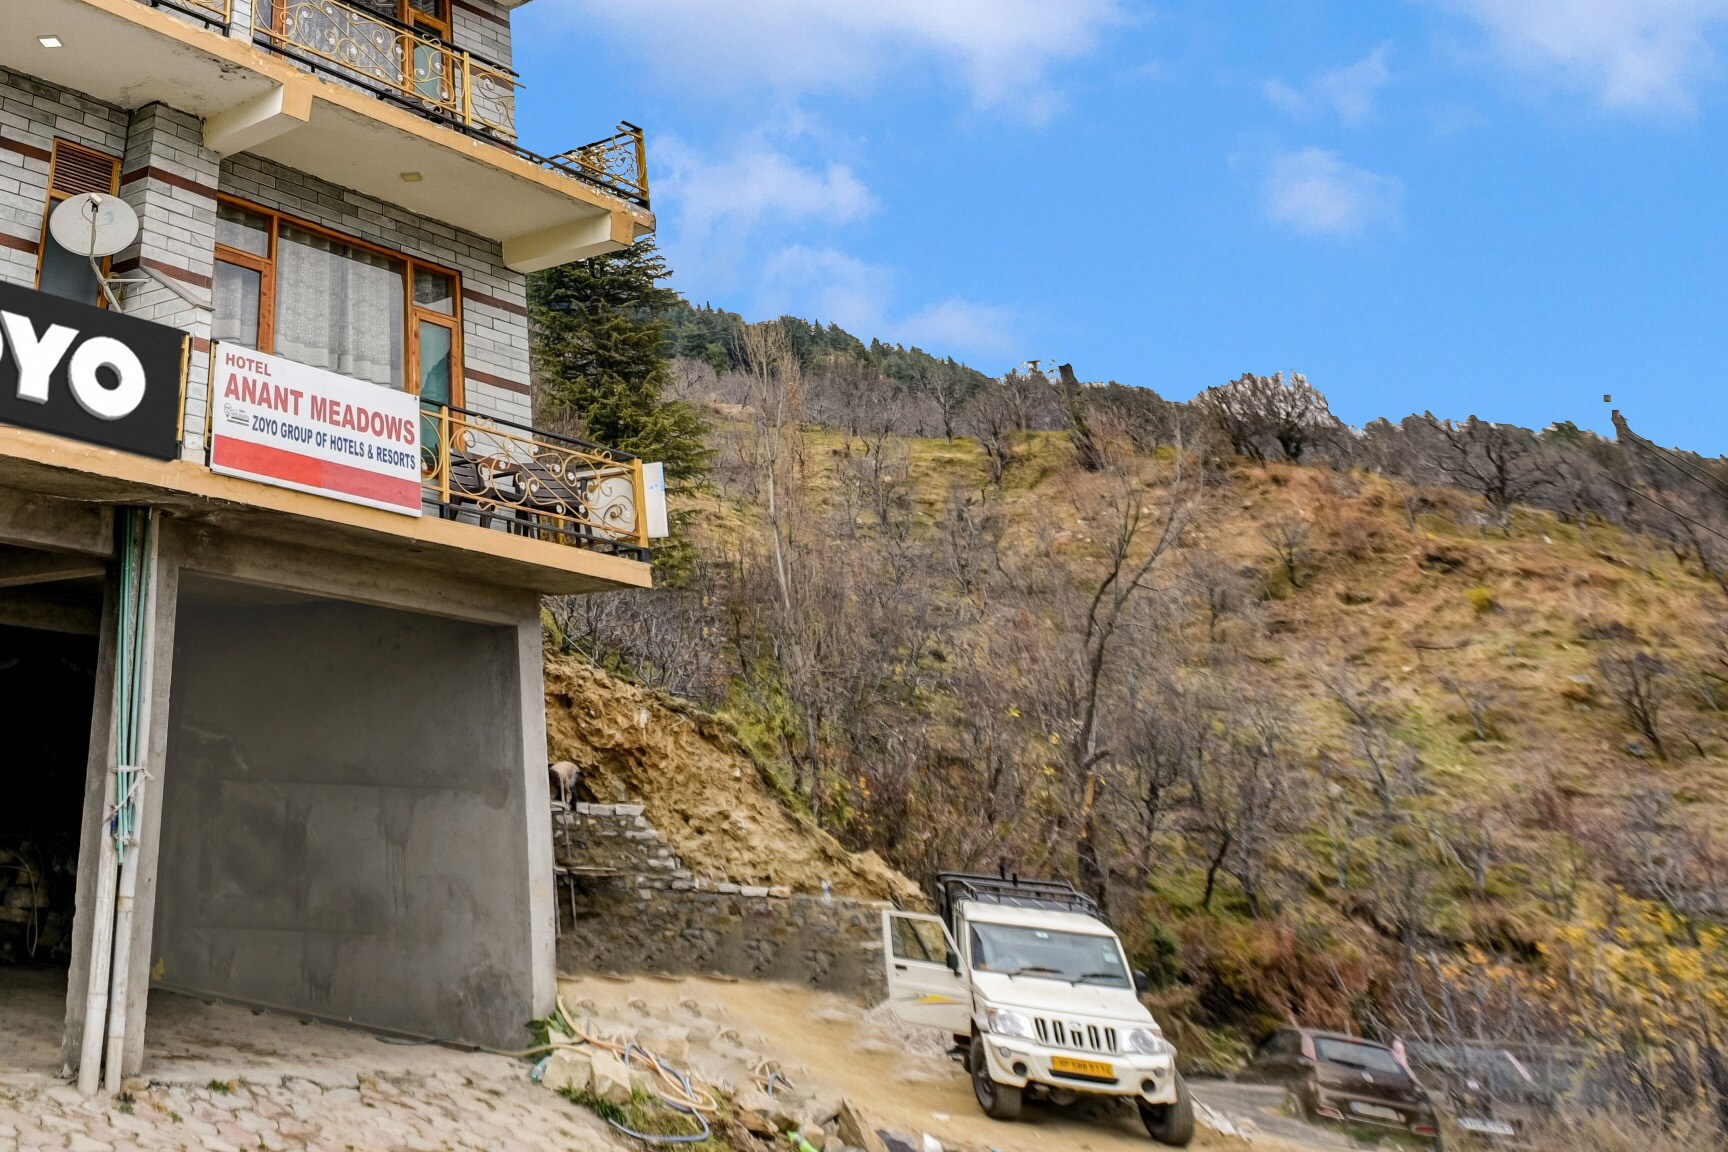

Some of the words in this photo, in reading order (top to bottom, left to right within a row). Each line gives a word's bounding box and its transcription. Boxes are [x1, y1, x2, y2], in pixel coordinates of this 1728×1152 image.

[225, 352, 271, 377] HOTEL
[224, 372, 303, 416] ANANT
[309, 395, 415, 446] MEADOWS
[252, 414, 278, 436] ZOYO
[280, 418, 313, 445] GROUP
[315, 431, 327, 447] OF
[330, 435, 365, 458] HOTELS
[367, 445, 374, 459] &
[376, 447, 416, 470] RESORTS
